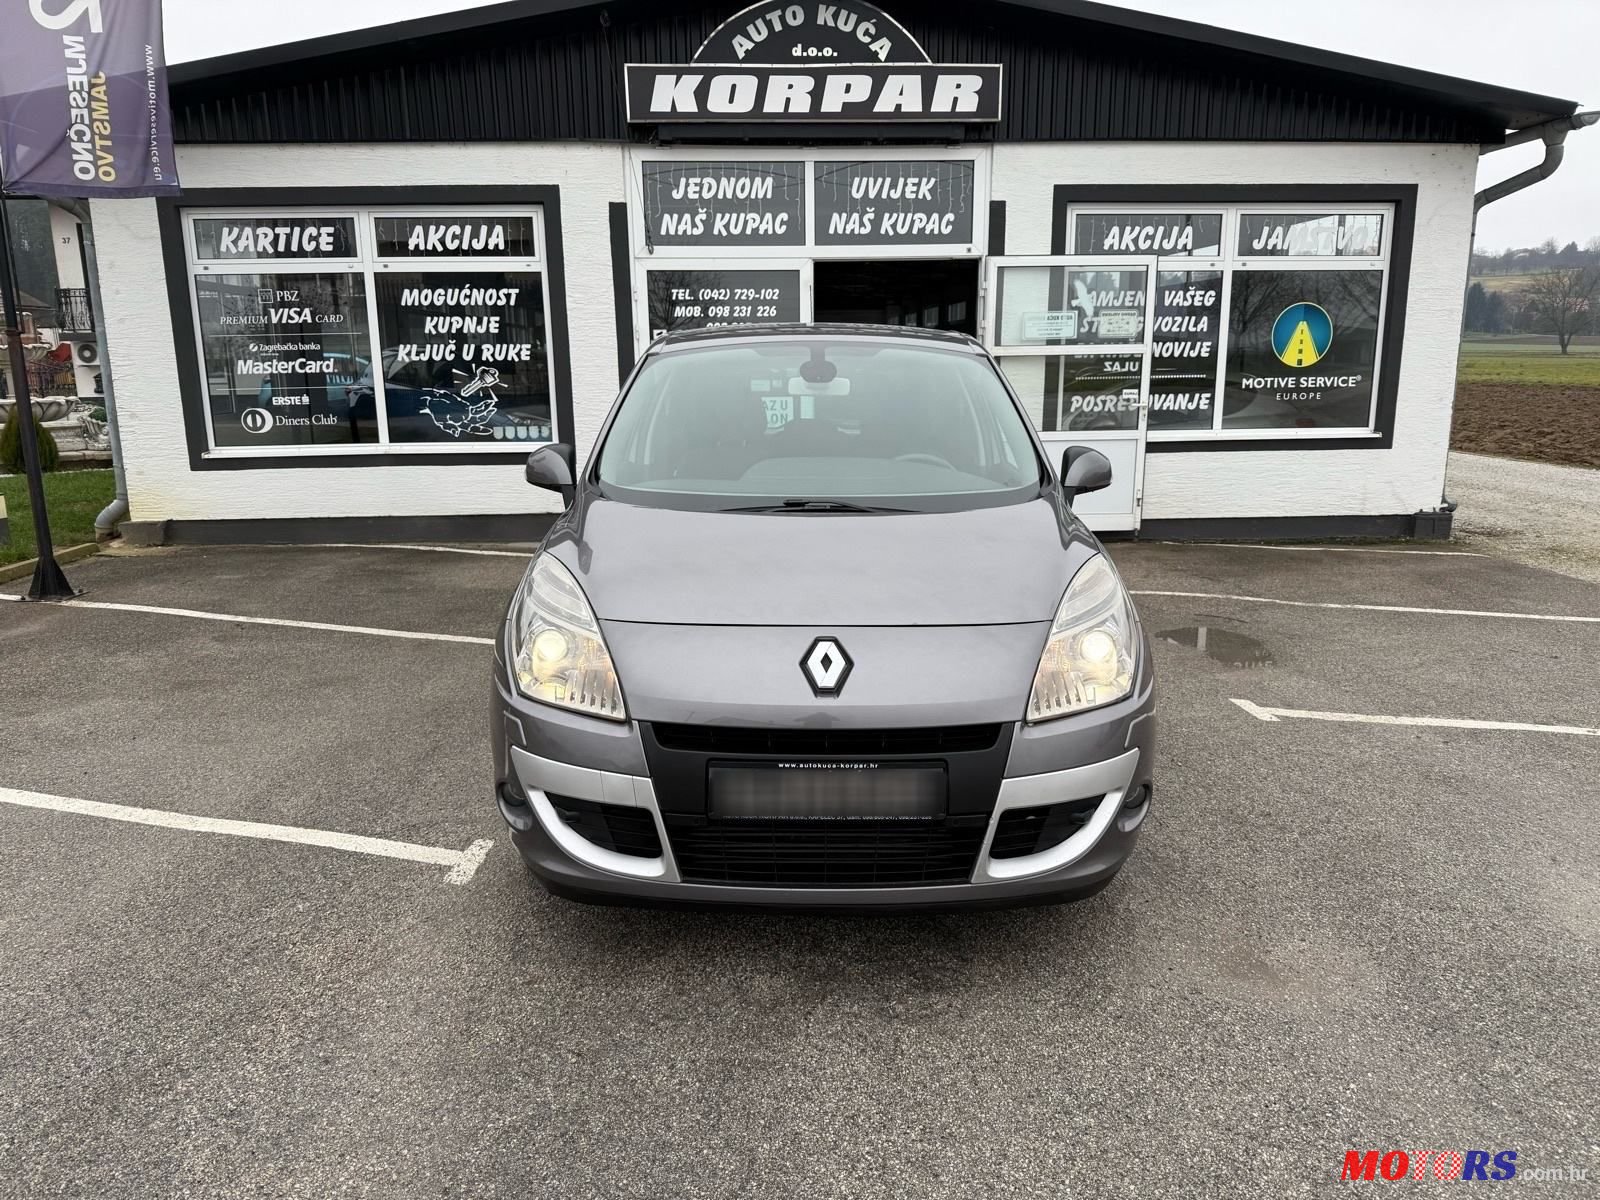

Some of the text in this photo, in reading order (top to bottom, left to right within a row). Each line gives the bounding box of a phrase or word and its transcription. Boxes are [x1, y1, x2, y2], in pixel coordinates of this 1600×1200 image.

[731, 4, 892, 62] AUTO KUĆA
[792, 43, 838, 57] d.o.o.
[649, 74, 984, 113] KORPAR
[671, 176, 774, 200] JEDNOM
[851, 177, 936, 200] UVIJEK
[660, 208, 789, 237] NAŠ KUPAC
[828, 207, 955, 237] NAŠ KUPAC
[61, 236, 71, 244] 37
[220, 226, 335, 254] KARTICE
[408, 225, 505, 252] AKCIJA
[1103, 225, 1193, 252] AKCIJA
[1252, 225, 1369, 250] JAMSTVO
[276, 290, 300, 302] PBZ
[401, 284, 520, 307] MOGUĆNOST
[671, 288, 779, 301] TEL. (042) 729-102
[1088, 286, 1217, 307] AMJEN VAŠEG
[220, 307, 344, 325] PREMIUM VISA CARD
[674, 306, 777, 318] MOB. 098 231 226
[424, 316, 500, 335] KUPNJE
[259, 342, 321, 353] Zagrebačka banka
[398, 340, 532, 362] KLJUČ U RUKE
[1152, 341, 1212, 358] NOVIJE
[1241, 376, 1296, 389] MOTIVE
[272, 395, 302, 406] ERSTE
[1276, 391, 1322, 400] EUROPE
[275, 413, 337, 426] Diners Club
